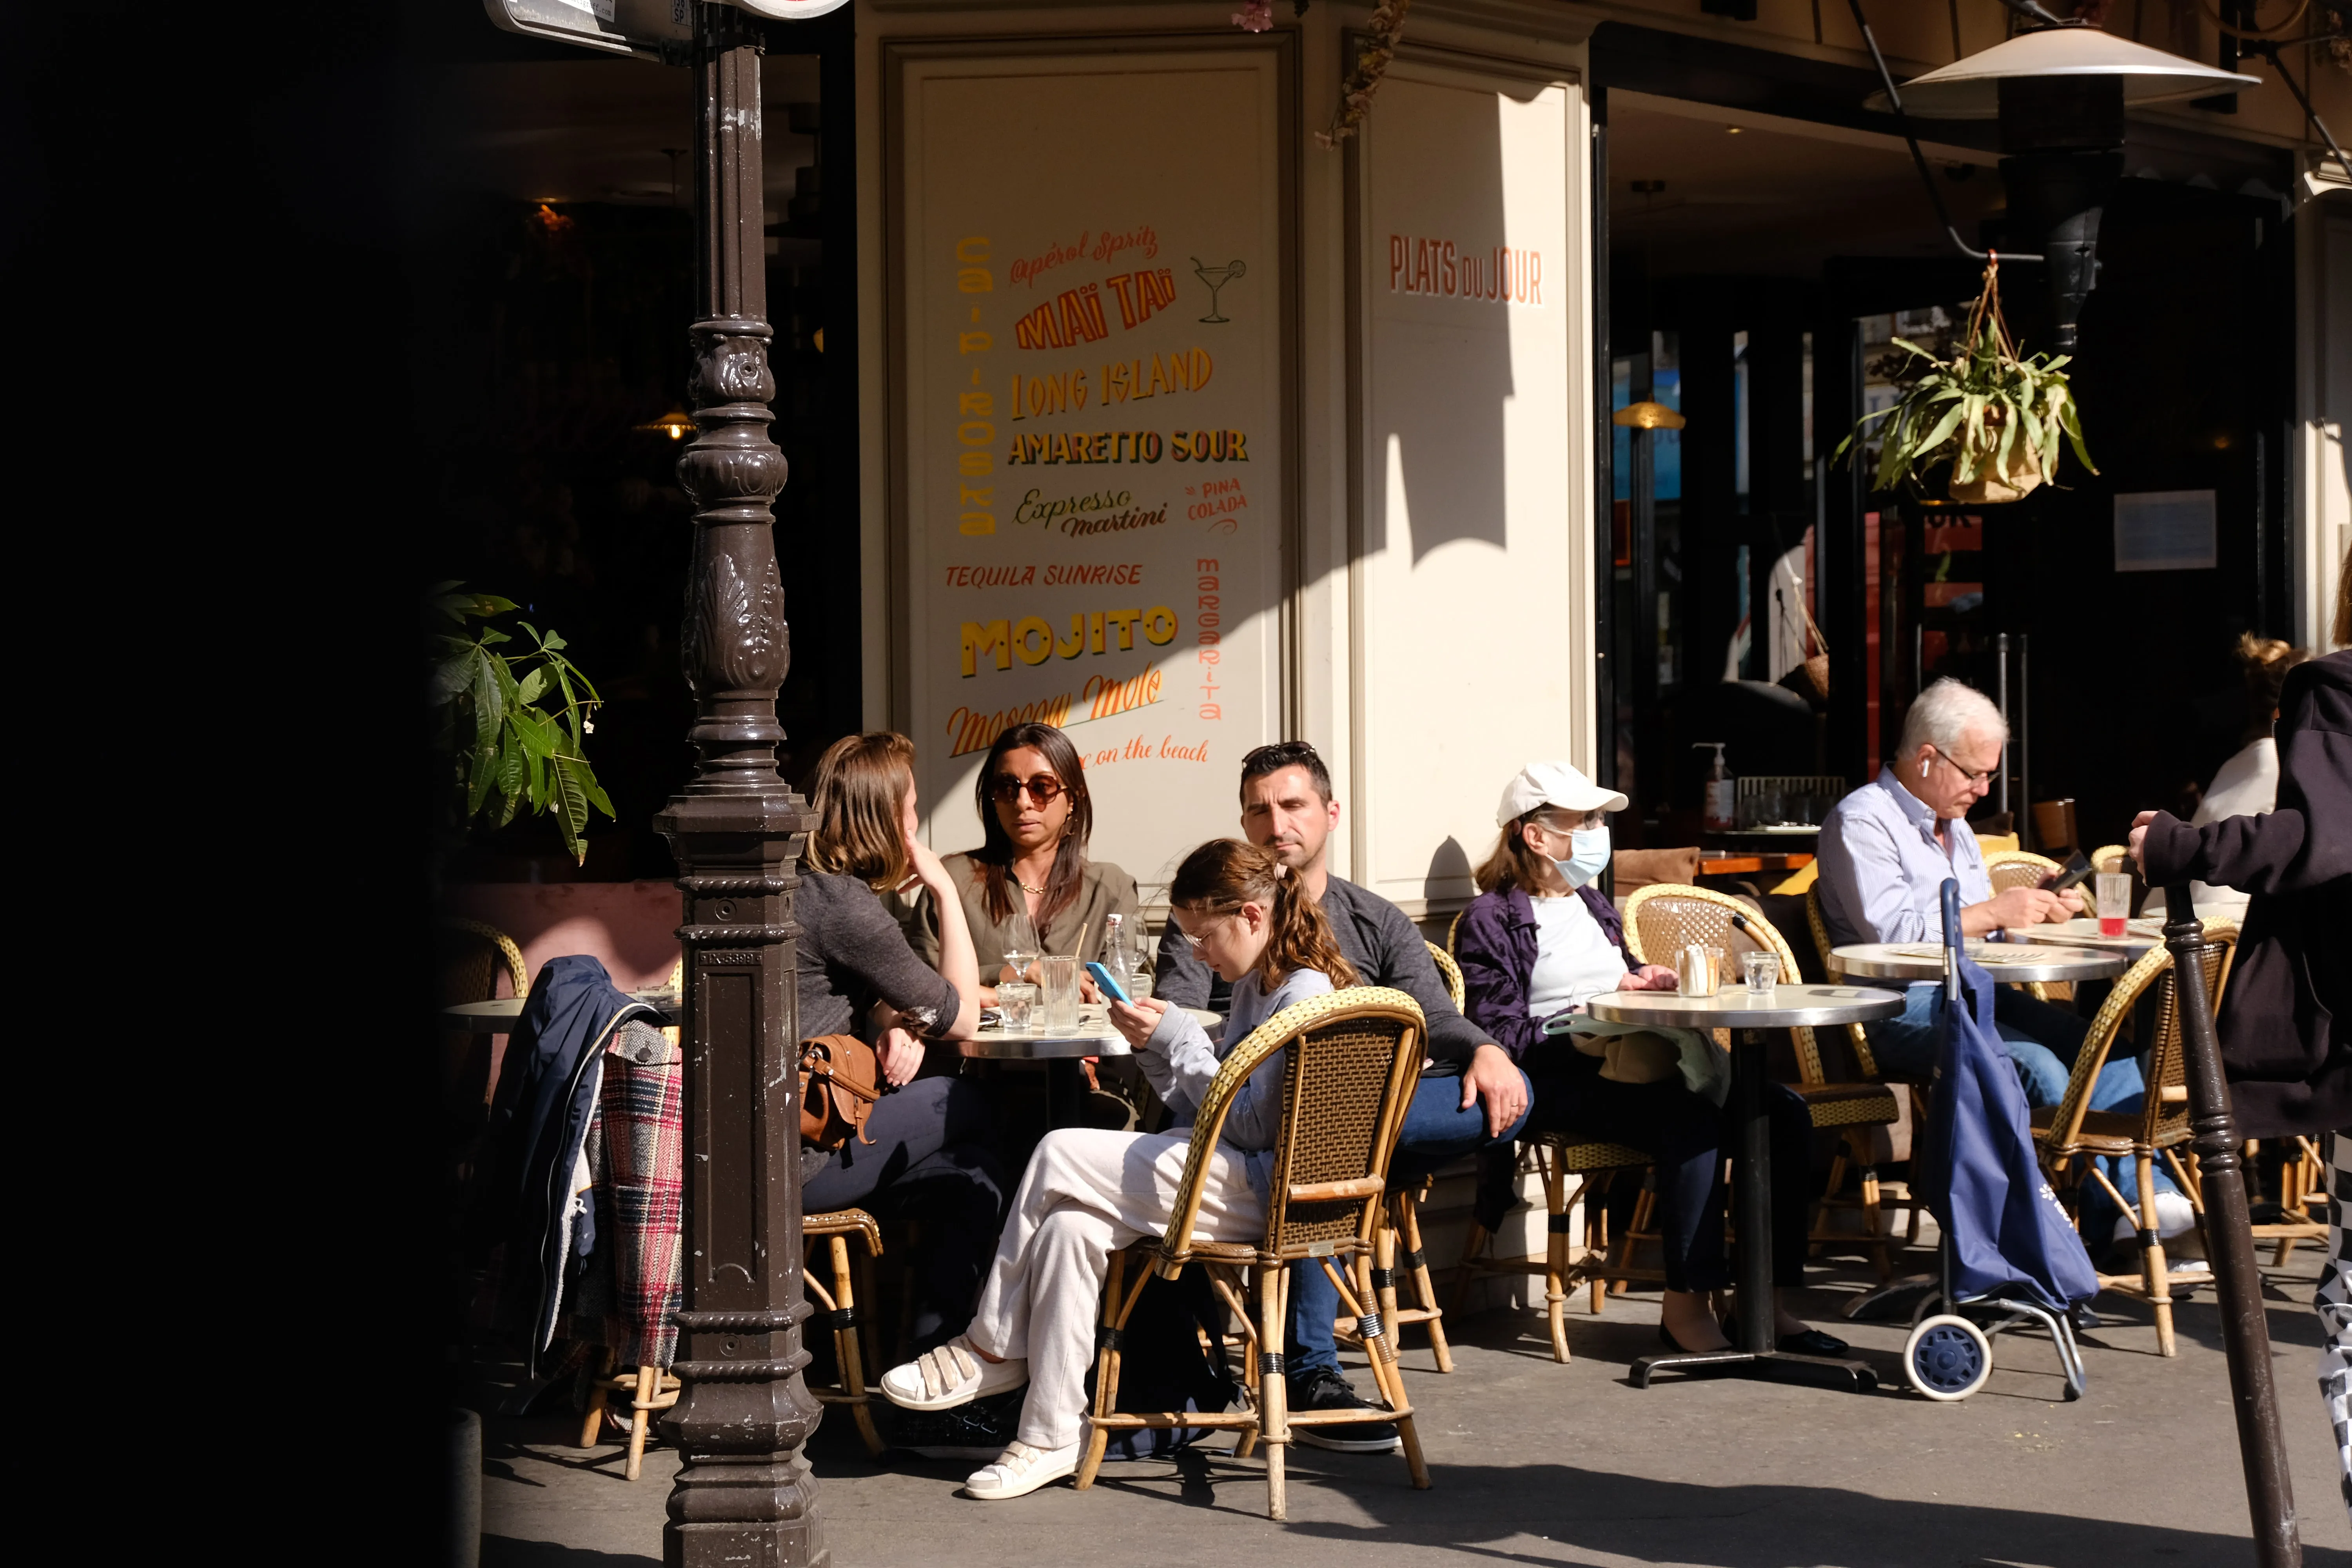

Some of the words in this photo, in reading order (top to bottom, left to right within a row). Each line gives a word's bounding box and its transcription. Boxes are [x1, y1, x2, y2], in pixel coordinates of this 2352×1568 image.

[674, 8, 684, 23] SP
[1091, 225, 1158, 265] Spritz
[1390, 234, 1458, 297] PLATS
[1463, 256, 1484, 300] DU
[1487, 246, 1544, 307] JOUR
[1015, 283, 1109, 350] MAÏ
[1105, 268, 1176, 330] TAÏ
[1012, 368, 1088, 421] LONG
[1102, 347, 1212, 406] ISLAND
[1008, 430, 1162, 465] AMARETTO
[1171, 430, 1249, 463] SOUR
[1202, 477, 1241, 498] PINA
[1011, 488, 1131, 530] Expresso
[1188, 494, 1247, 521] COLADA
[946, 566, 1035, 588] TEQUILA
[1044, 564, 1143, 585] SUNRISE
[961, 606, 1178, 678] MOJITO
[1093, 747, 1118, 767] on
[1122, 734, 1152, 760] the
[1156, 735, 1209, 763] beach
